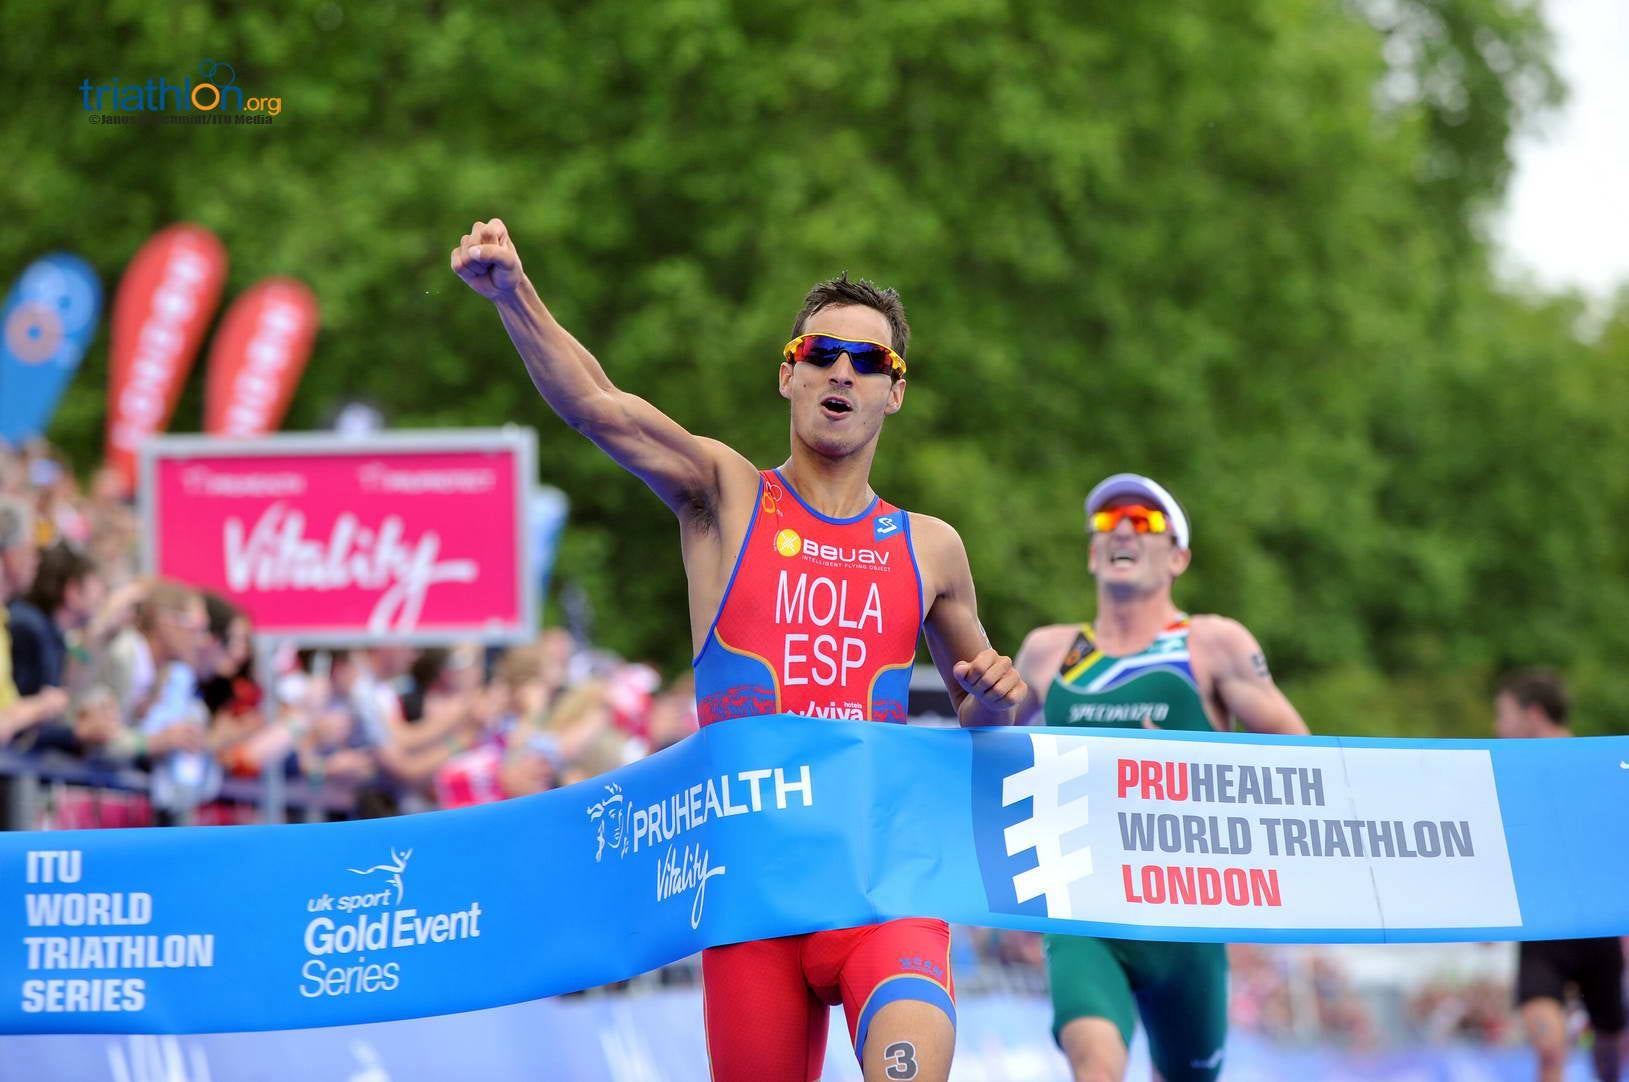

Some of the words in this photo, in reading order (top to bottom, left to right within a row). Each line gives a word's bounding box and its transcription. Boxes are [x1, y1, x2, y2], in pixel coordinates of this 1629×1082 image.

[223, 500, 478, 633] Vitality
[802, 555, 842, 567] INTELLIGENT
[775, 569, 883, 634] MOLA
[783, 633, 867, 687] ESP
[844, 701, 862, 709] hotels
[1117, 758, 1326, 806] PRUHEALTH
[633, 765, 813, 853] PRUHEALTH
[1117, 811, 1252, 855] WORLD
[1259, 817, 1475, 858] TRIATHLON
[26, 850, 83, 884] ITU
[656, 842, 726, 930] Vitality
[1121, 863, 1283, 907] LONDON
[25, 892, 153, 927] WORLD
[307, 894, 334, 913] uk
[337, 889, 392, 914] sport
[304, 912, 390, 956] Gold
[392, 901, 482, 948] Event
[23, 934, 215, 970] TRIATHLON
[21, 978, 146, 1014] SERIES
[300, 956, 400, 998] Series
[884, 1040, 918, 1080] 3
